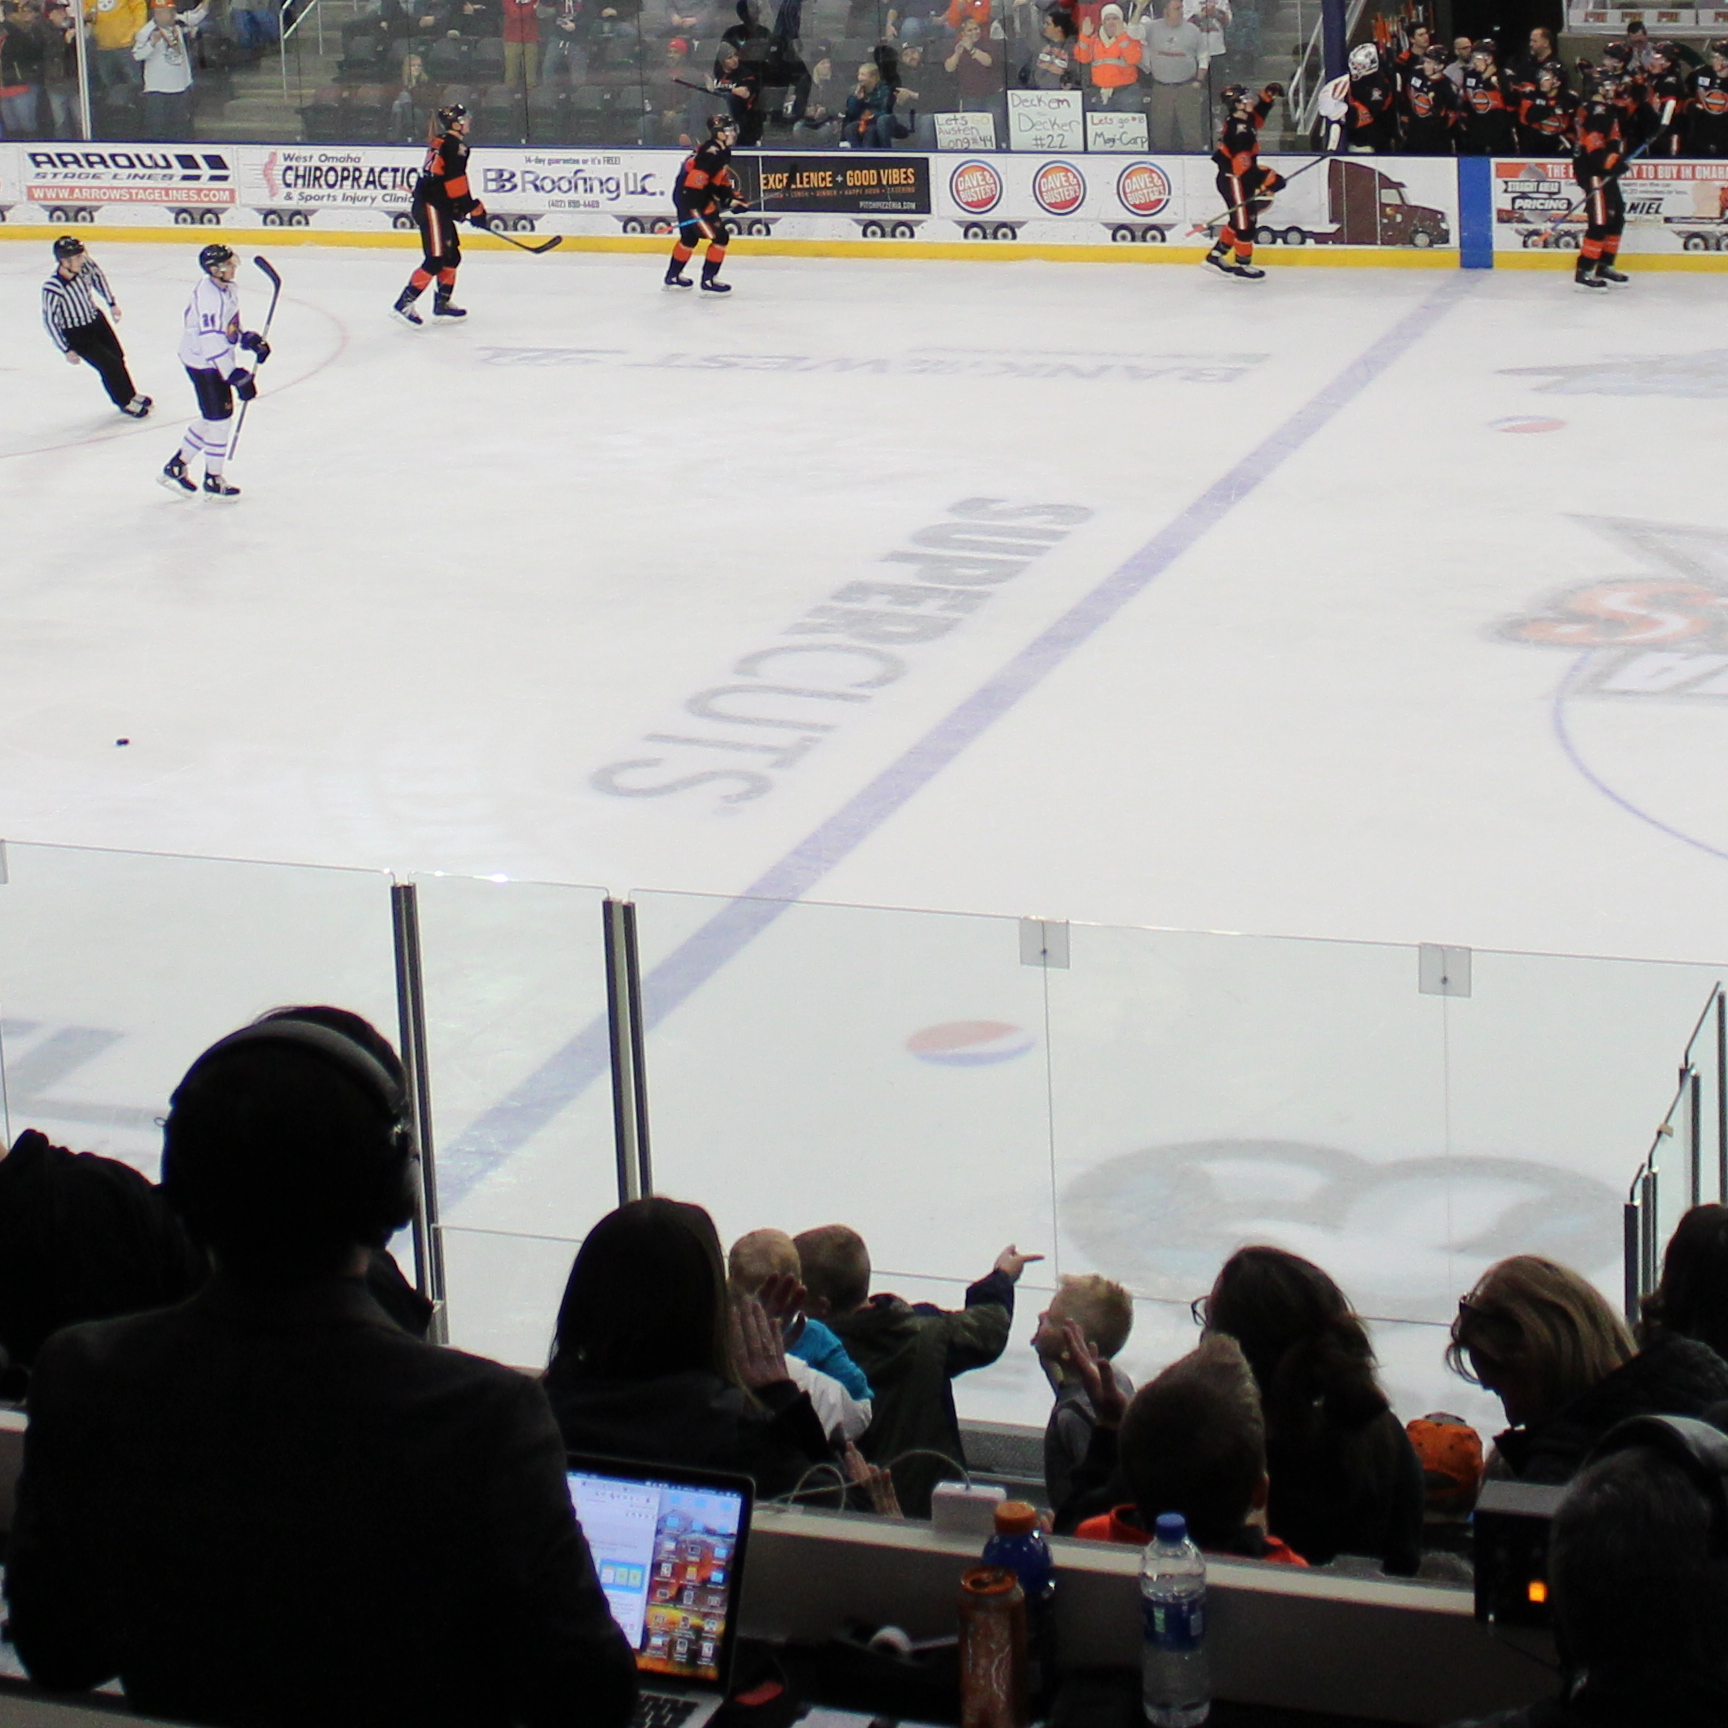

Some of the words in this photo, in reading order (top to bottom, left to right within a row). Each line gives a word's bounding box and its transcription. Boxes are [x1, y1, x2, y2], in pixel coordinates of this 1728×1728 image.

[936, 114, 968, 126] Lets
[1017, 112, 1079, 134] Decker
[939, 136, 971, 149] Long
[1032, 134, 1069, 150] #22
[27, 152, 172, 170] ARROW
[282, 153, 315, 164] West
[318, 153, 362, 164] Omaha
[581, 157, 589, 165] or
[33, 171, 108, 181] STAGE
[112, 171, 174, 182] LINES
[282, 166, 422, 190] CHIROPRACTIO
[846, 170, 877, 186] GOOD
[880, 168, 915, 186] VIBES
[1546, 164, 1566, 179] THE
[1641, 165, 1655, 179] TO
[1657, 165, 1679, 179] BUY
[1681, 165, 1693, 179] IN
[521, 169, 621, 201] Roofing
[624, 172, 665, 197] LLC.
[958, 171, 985, 190] DAVE
[984, 170, 994, 183] &
[1041, 172, 1068, 191] DAVE
[1067, 171, 1077, 184] &
[1125, 174, 1152, 193] DAVE
[1151, 173, 1161, 186] &
[31, 187, 231, 203] WWW.ARROWSTAGELINES.COM
[284, 192, 294, 202] &
[296, 191, 338, 204] Sports
[341, 191, 378, 205] Injury
[1514, 199, 1568, 211] PRICING
[588, 496, 1092, 817] SUPERCUTS
